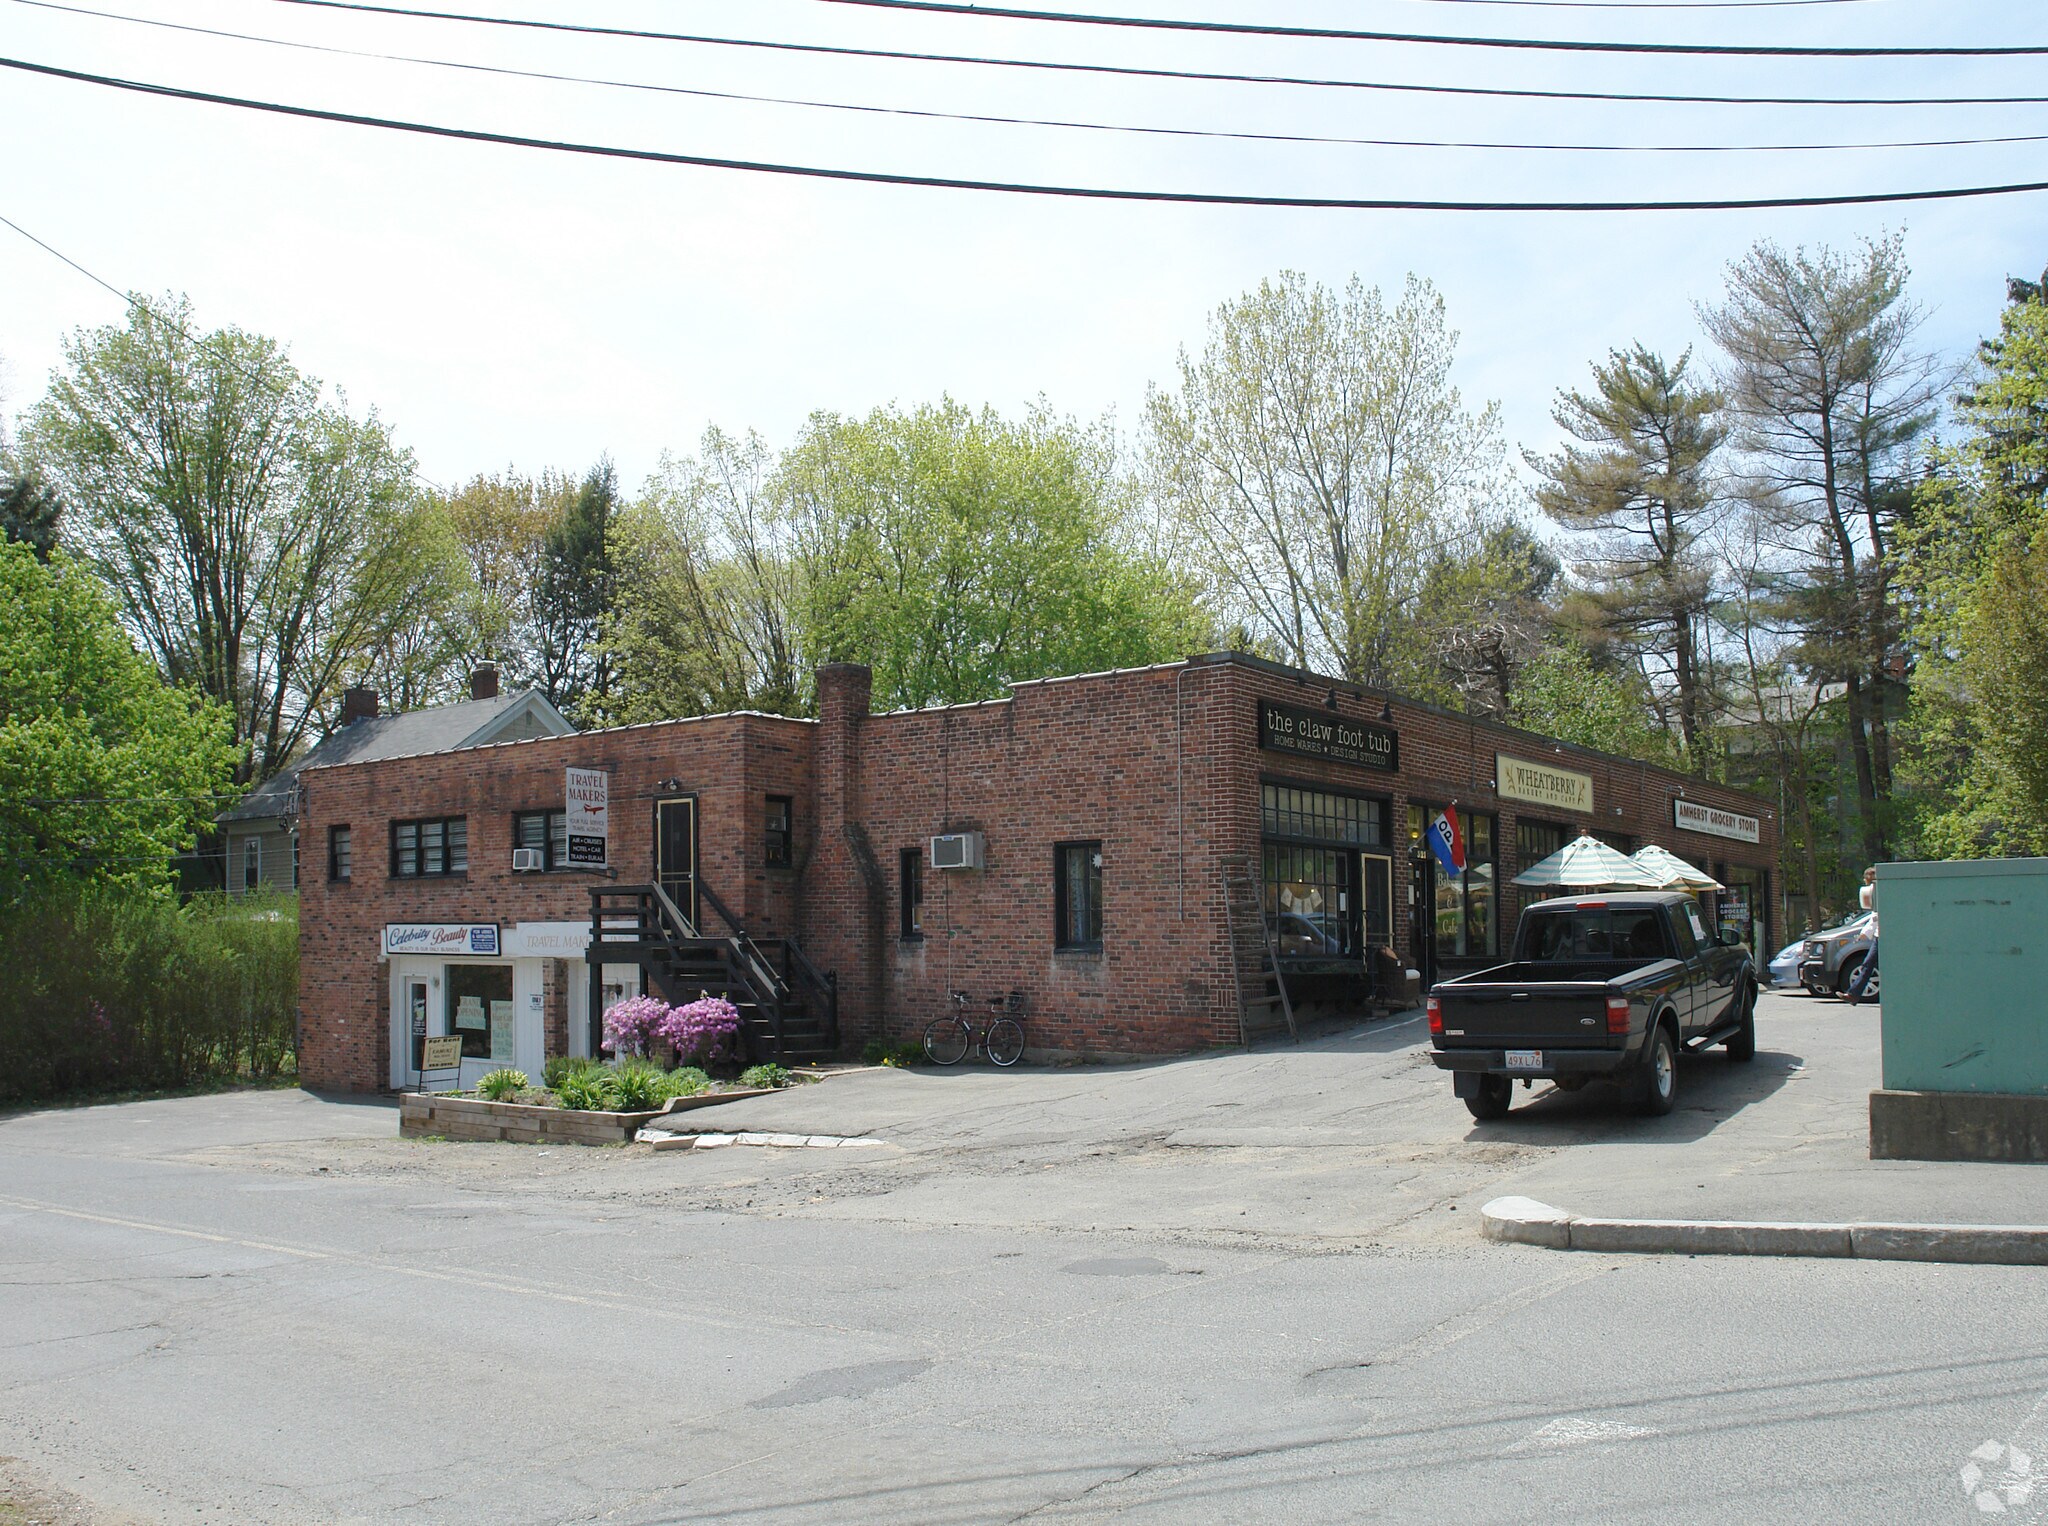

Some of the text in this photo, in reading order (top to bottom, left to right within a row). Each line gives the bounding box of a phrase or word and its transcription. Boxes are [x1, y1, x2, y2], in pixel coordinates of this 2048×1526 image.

[1267, 709, 1391, 753] the claw foot tub
[1274, 734, 1386, 766] HOME WARES DESIGN STUDIO
[570, 773, 604, 788] TRAVEL
[1516, 767, 1576, 796] WHEATBERRY
[568, 788, 606, 802] MAKERS
[1679, 804, 1708, 822] AMHERST
[1710, 811, 1737, 830] GROCERY
[1738, 818, 1756, 833] STORE
[1438, 820, 1454, 846] OP
[389, 928, 431, 947] Celebrity
[431, 927, 468, 945] Beauty
[526, 936, 560, 948] TRAVEL
[1508, 1055, 1541, 1067] 49X L76
